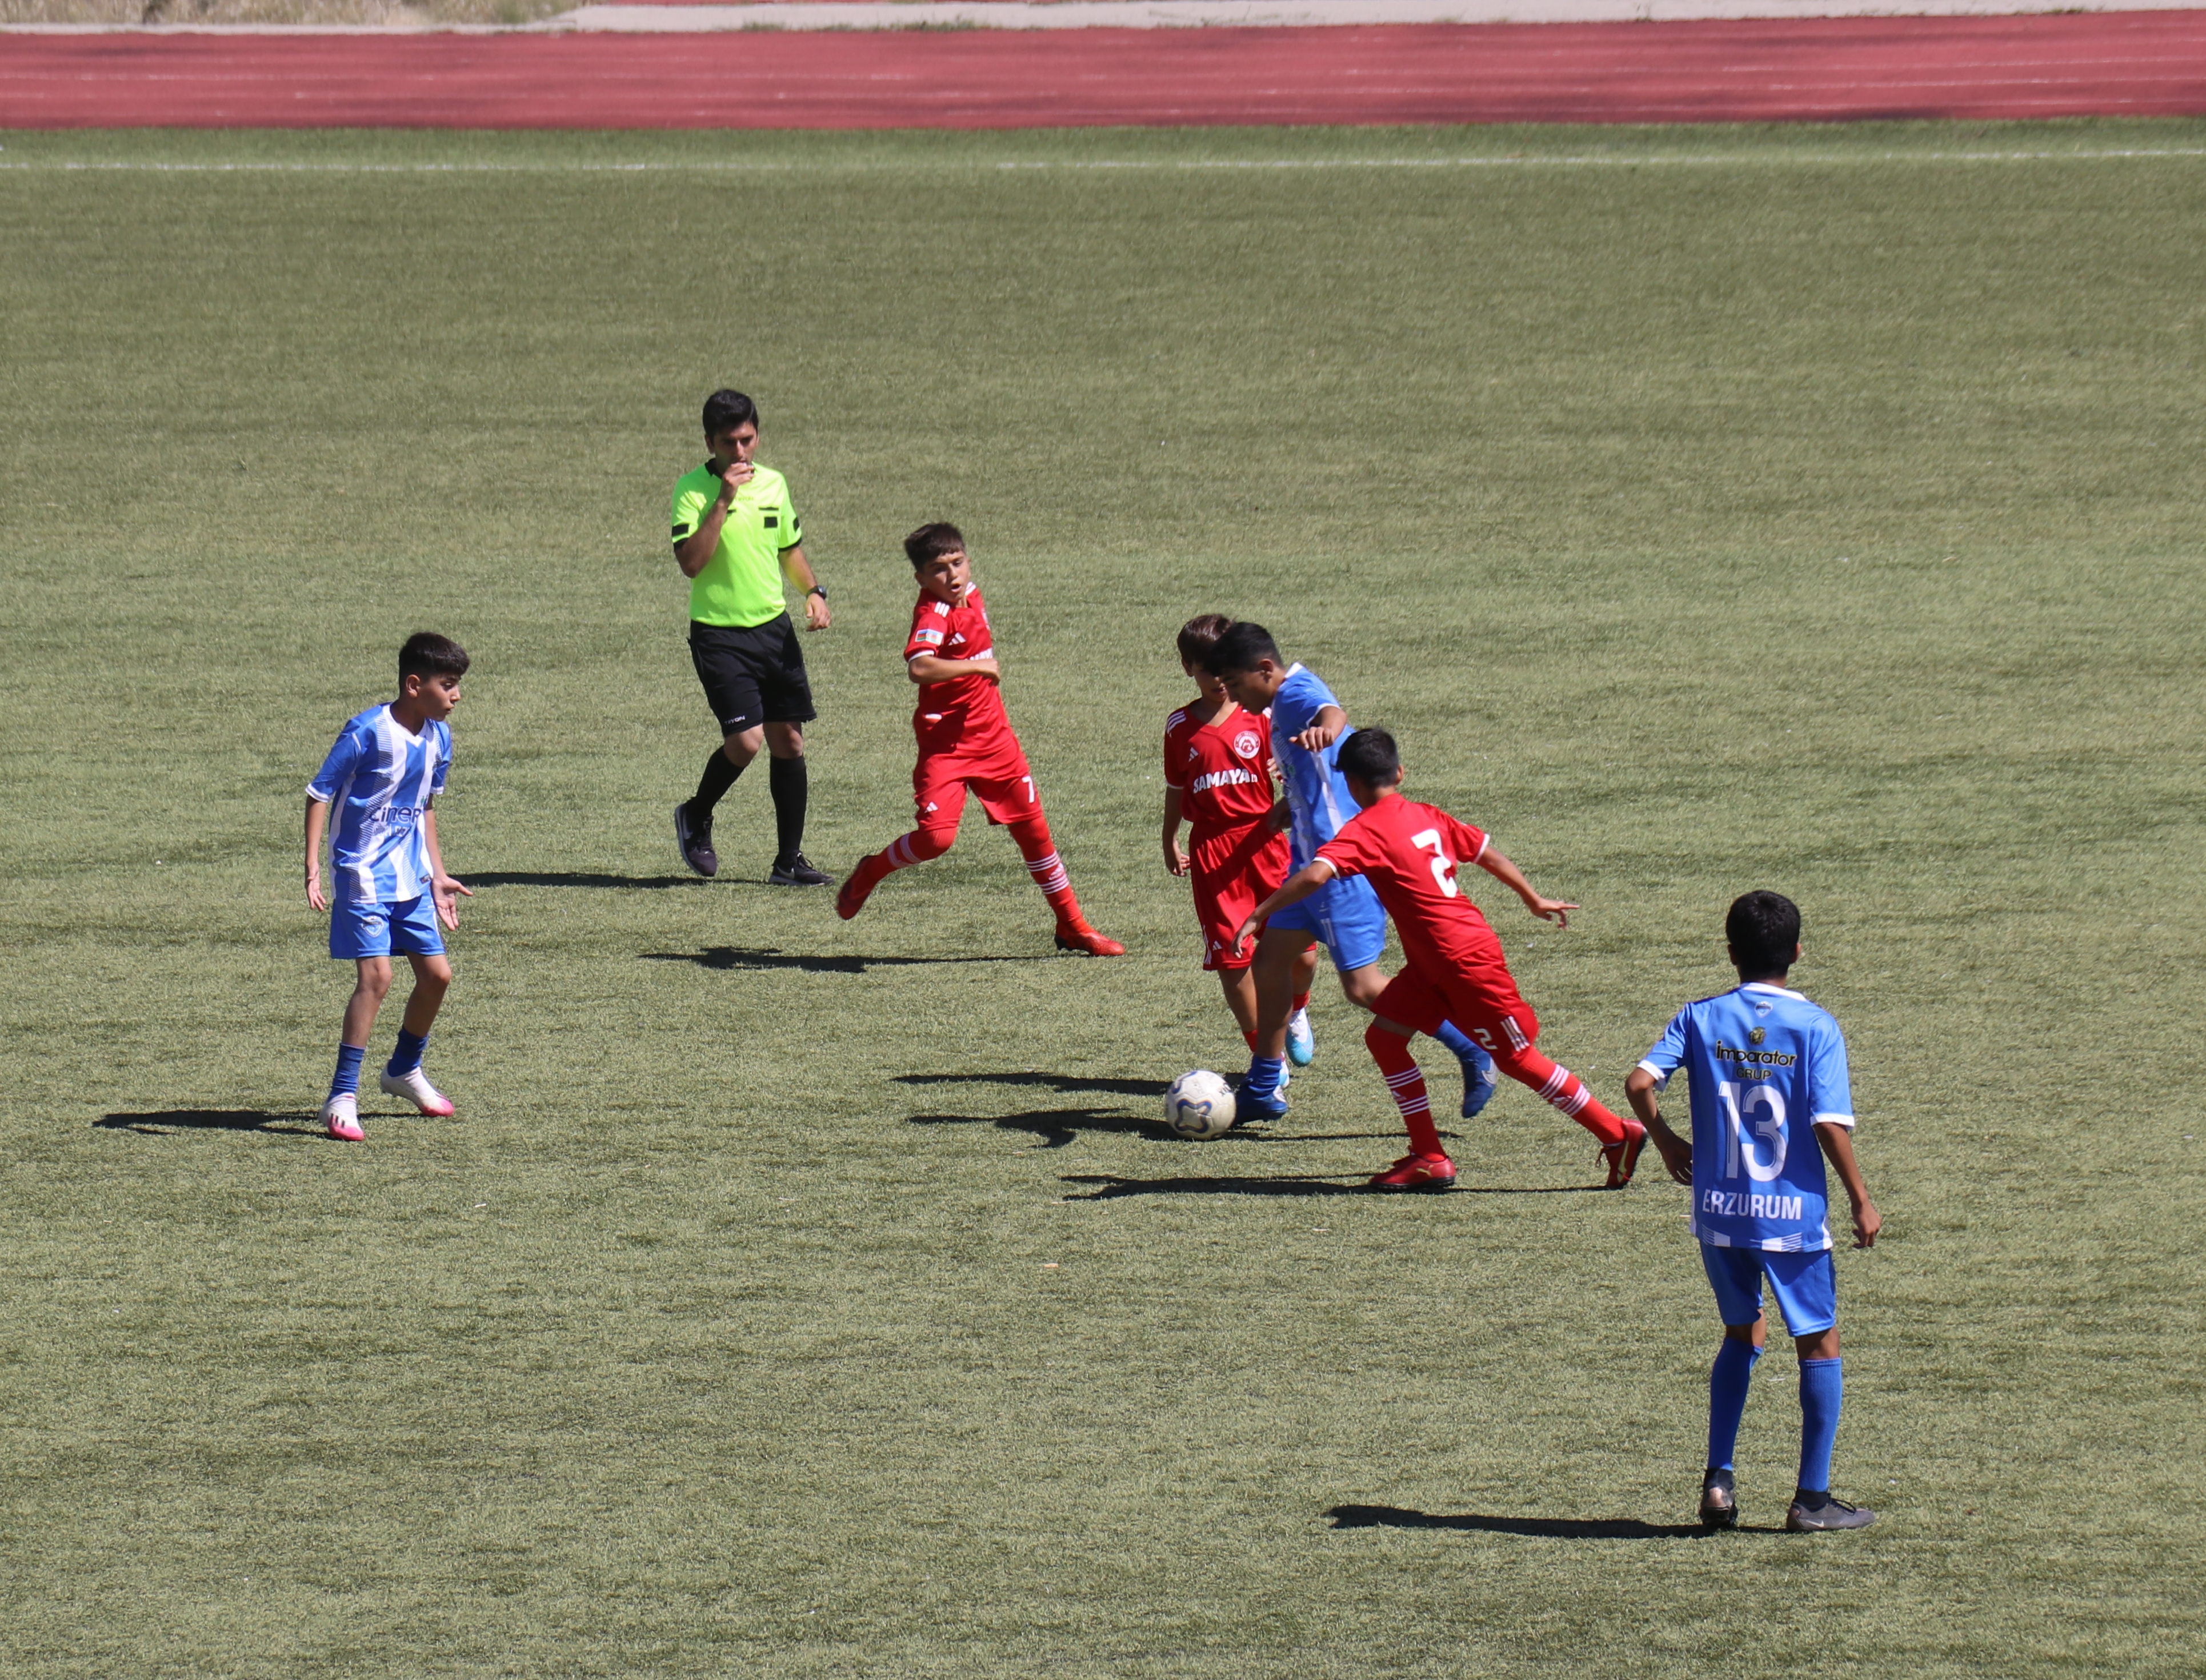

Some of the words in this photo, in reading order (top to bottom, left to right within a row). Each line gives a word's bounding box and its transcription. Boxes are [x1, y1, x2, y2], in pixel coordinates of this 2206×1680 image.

[1022, 776, 1035, 803] 7
[1193, 768, 1250, 793] SAMAYA
[1410, 828, 1459, 898] 2
[1474, 1028, 1497, 1049] 2
[1736, 1066, 1772, 1080] GRUP
[1718, 1081, 1786, 1182] 13
[1702, 1188, 1802, 1221] ERZURUM
